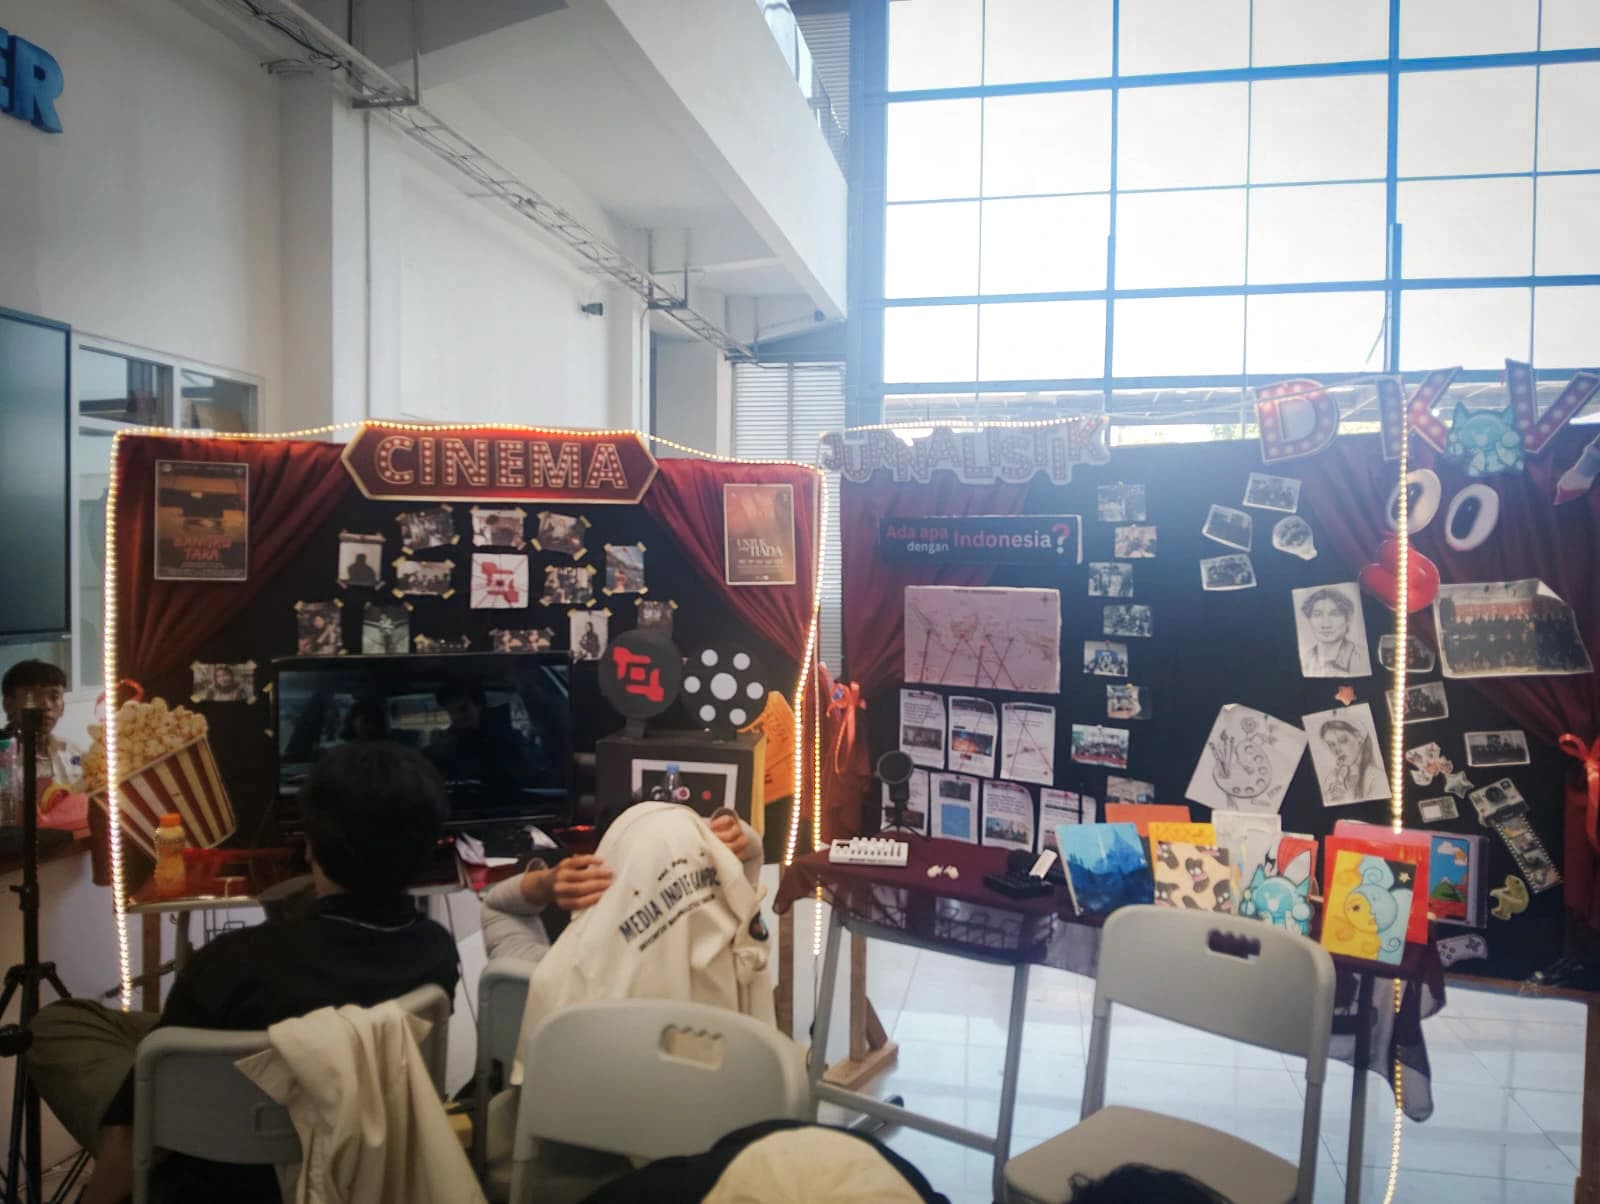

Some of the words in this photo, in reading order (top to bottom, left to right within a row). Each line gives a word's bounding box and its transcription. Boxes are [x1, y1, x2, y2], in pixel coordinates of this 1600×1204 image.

[0, 26, 64, 133] R
[374, 434, 629, 490] CINEMA
[886, 525, 916, 540] Ada
[920, 527, 949, 543] apa
[907, 540, 949, 554] dengan
[618, 899, 663, 943] MEDIA
